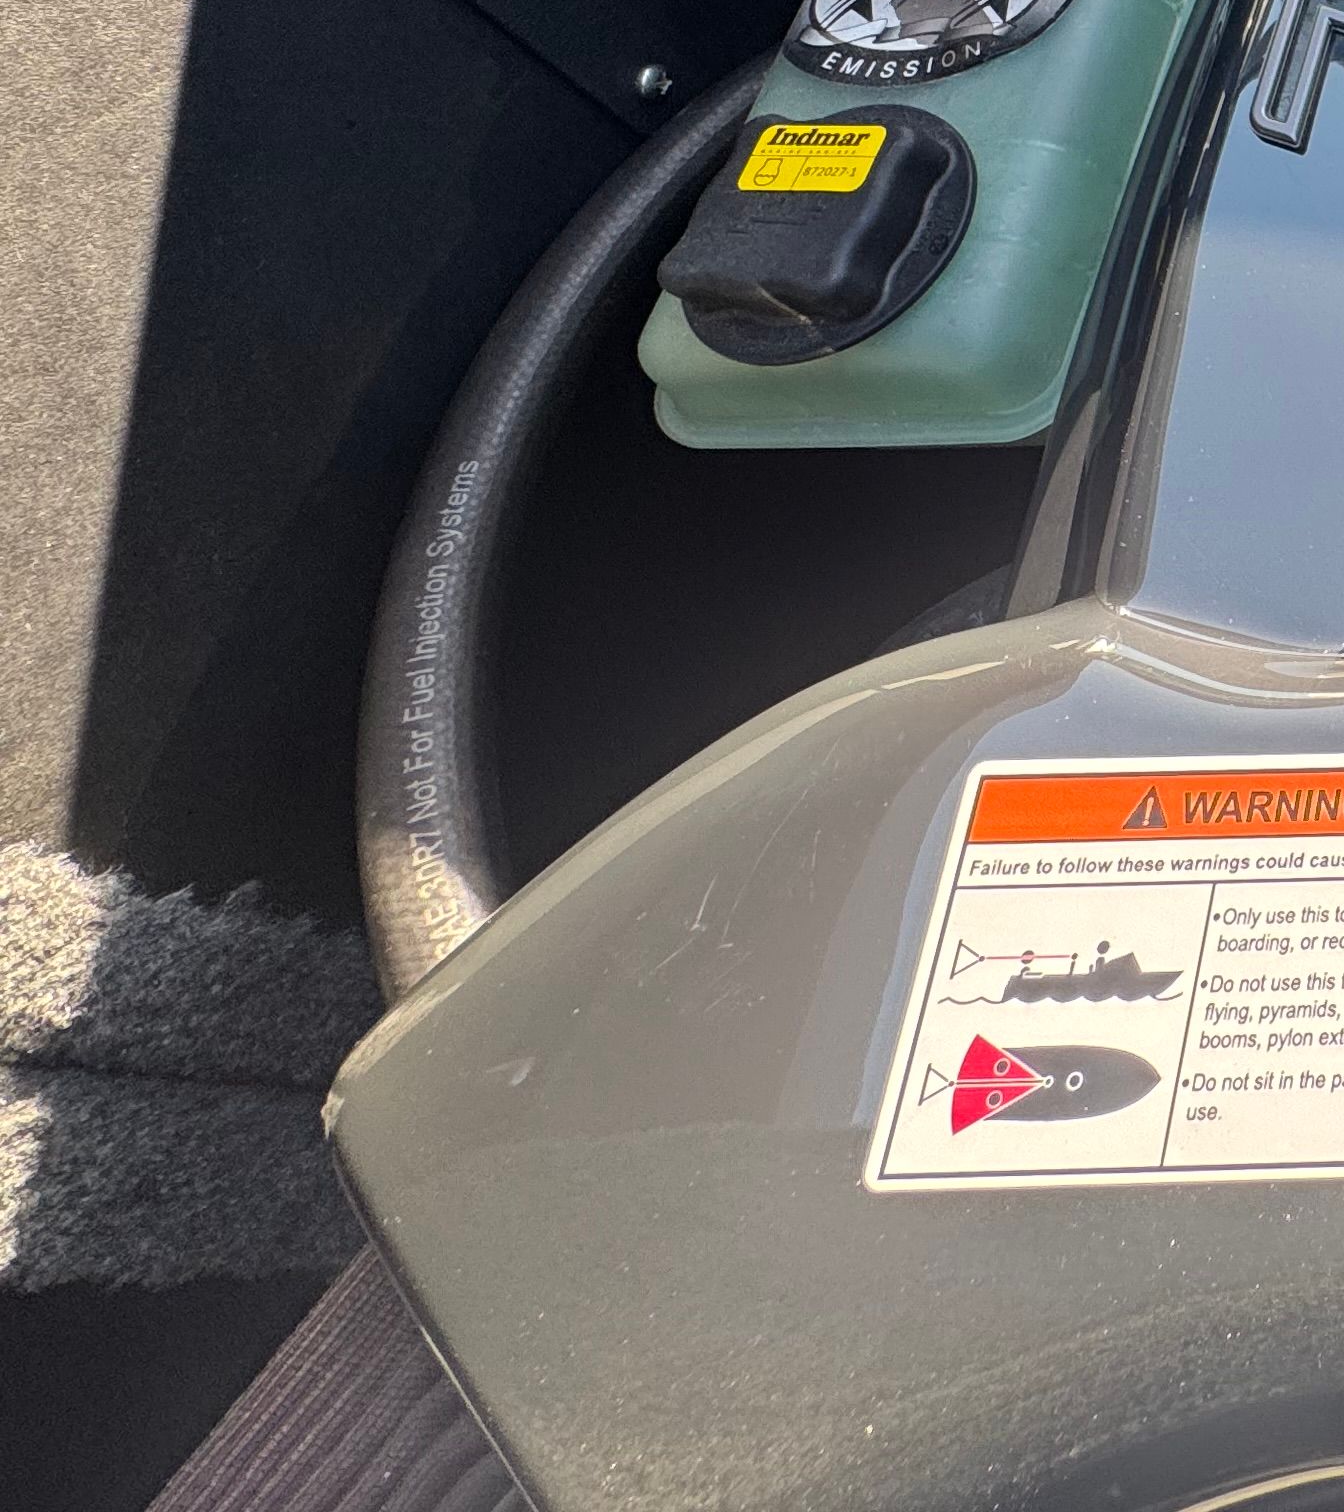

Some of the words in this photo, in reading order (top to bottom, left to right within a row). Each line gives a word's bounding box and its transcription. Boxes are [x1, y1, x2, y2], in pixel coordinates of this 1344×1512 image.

[821, 41, 982, 78] EMISSION
[767, 128, 870, 146] Indmar
[426, 459, 480, 558] Systems
[406, 564, 449, 663] Injection
[402, 668, 436, 724] Fuel
[402, 729, 434, 774] For
[406, 775, 439, 824] Not
[969, 859, 1031, 876] Failure
[1036, 860, 1053, 875] to
[1058, 858, 1114, 875] follow
[1117, 857, 1165, 873] these
[1171, 855, 1249, 873] warnings
[1256, 853, 1304, 869] could
[1223, 907, 1262, 930] Only
[1265, 910, 1296, 925] use
[1301, 905, 1330, 924] this
[1216, 933, 1294, 956] boarding,
[1300, 935, 1319, 951] or
[1209, 974, 1234, 993] Do
[1238, 974, 1267, 993] not
[1270, 977, 1302, 992] use
[1306, 971, 1336, 991] this
[1204, 1002, 1253, 1026] flying,
[1258, 999, 1341, 1025] pyramids,
[1199, 1030, 1261, 1051] booms,
[1266, 1028, 1314, 1052] pylon
[1191, 1072, 1217, 1092] Do
[1221, 1072, 1250, 1092] not
[1253, 1071, 1275, 1091] sit
[1278, 1070, 1294, 1090] in
[1299, 1069, 1326, 1089] the
[1186, 1106, 1222, 1121] use.
